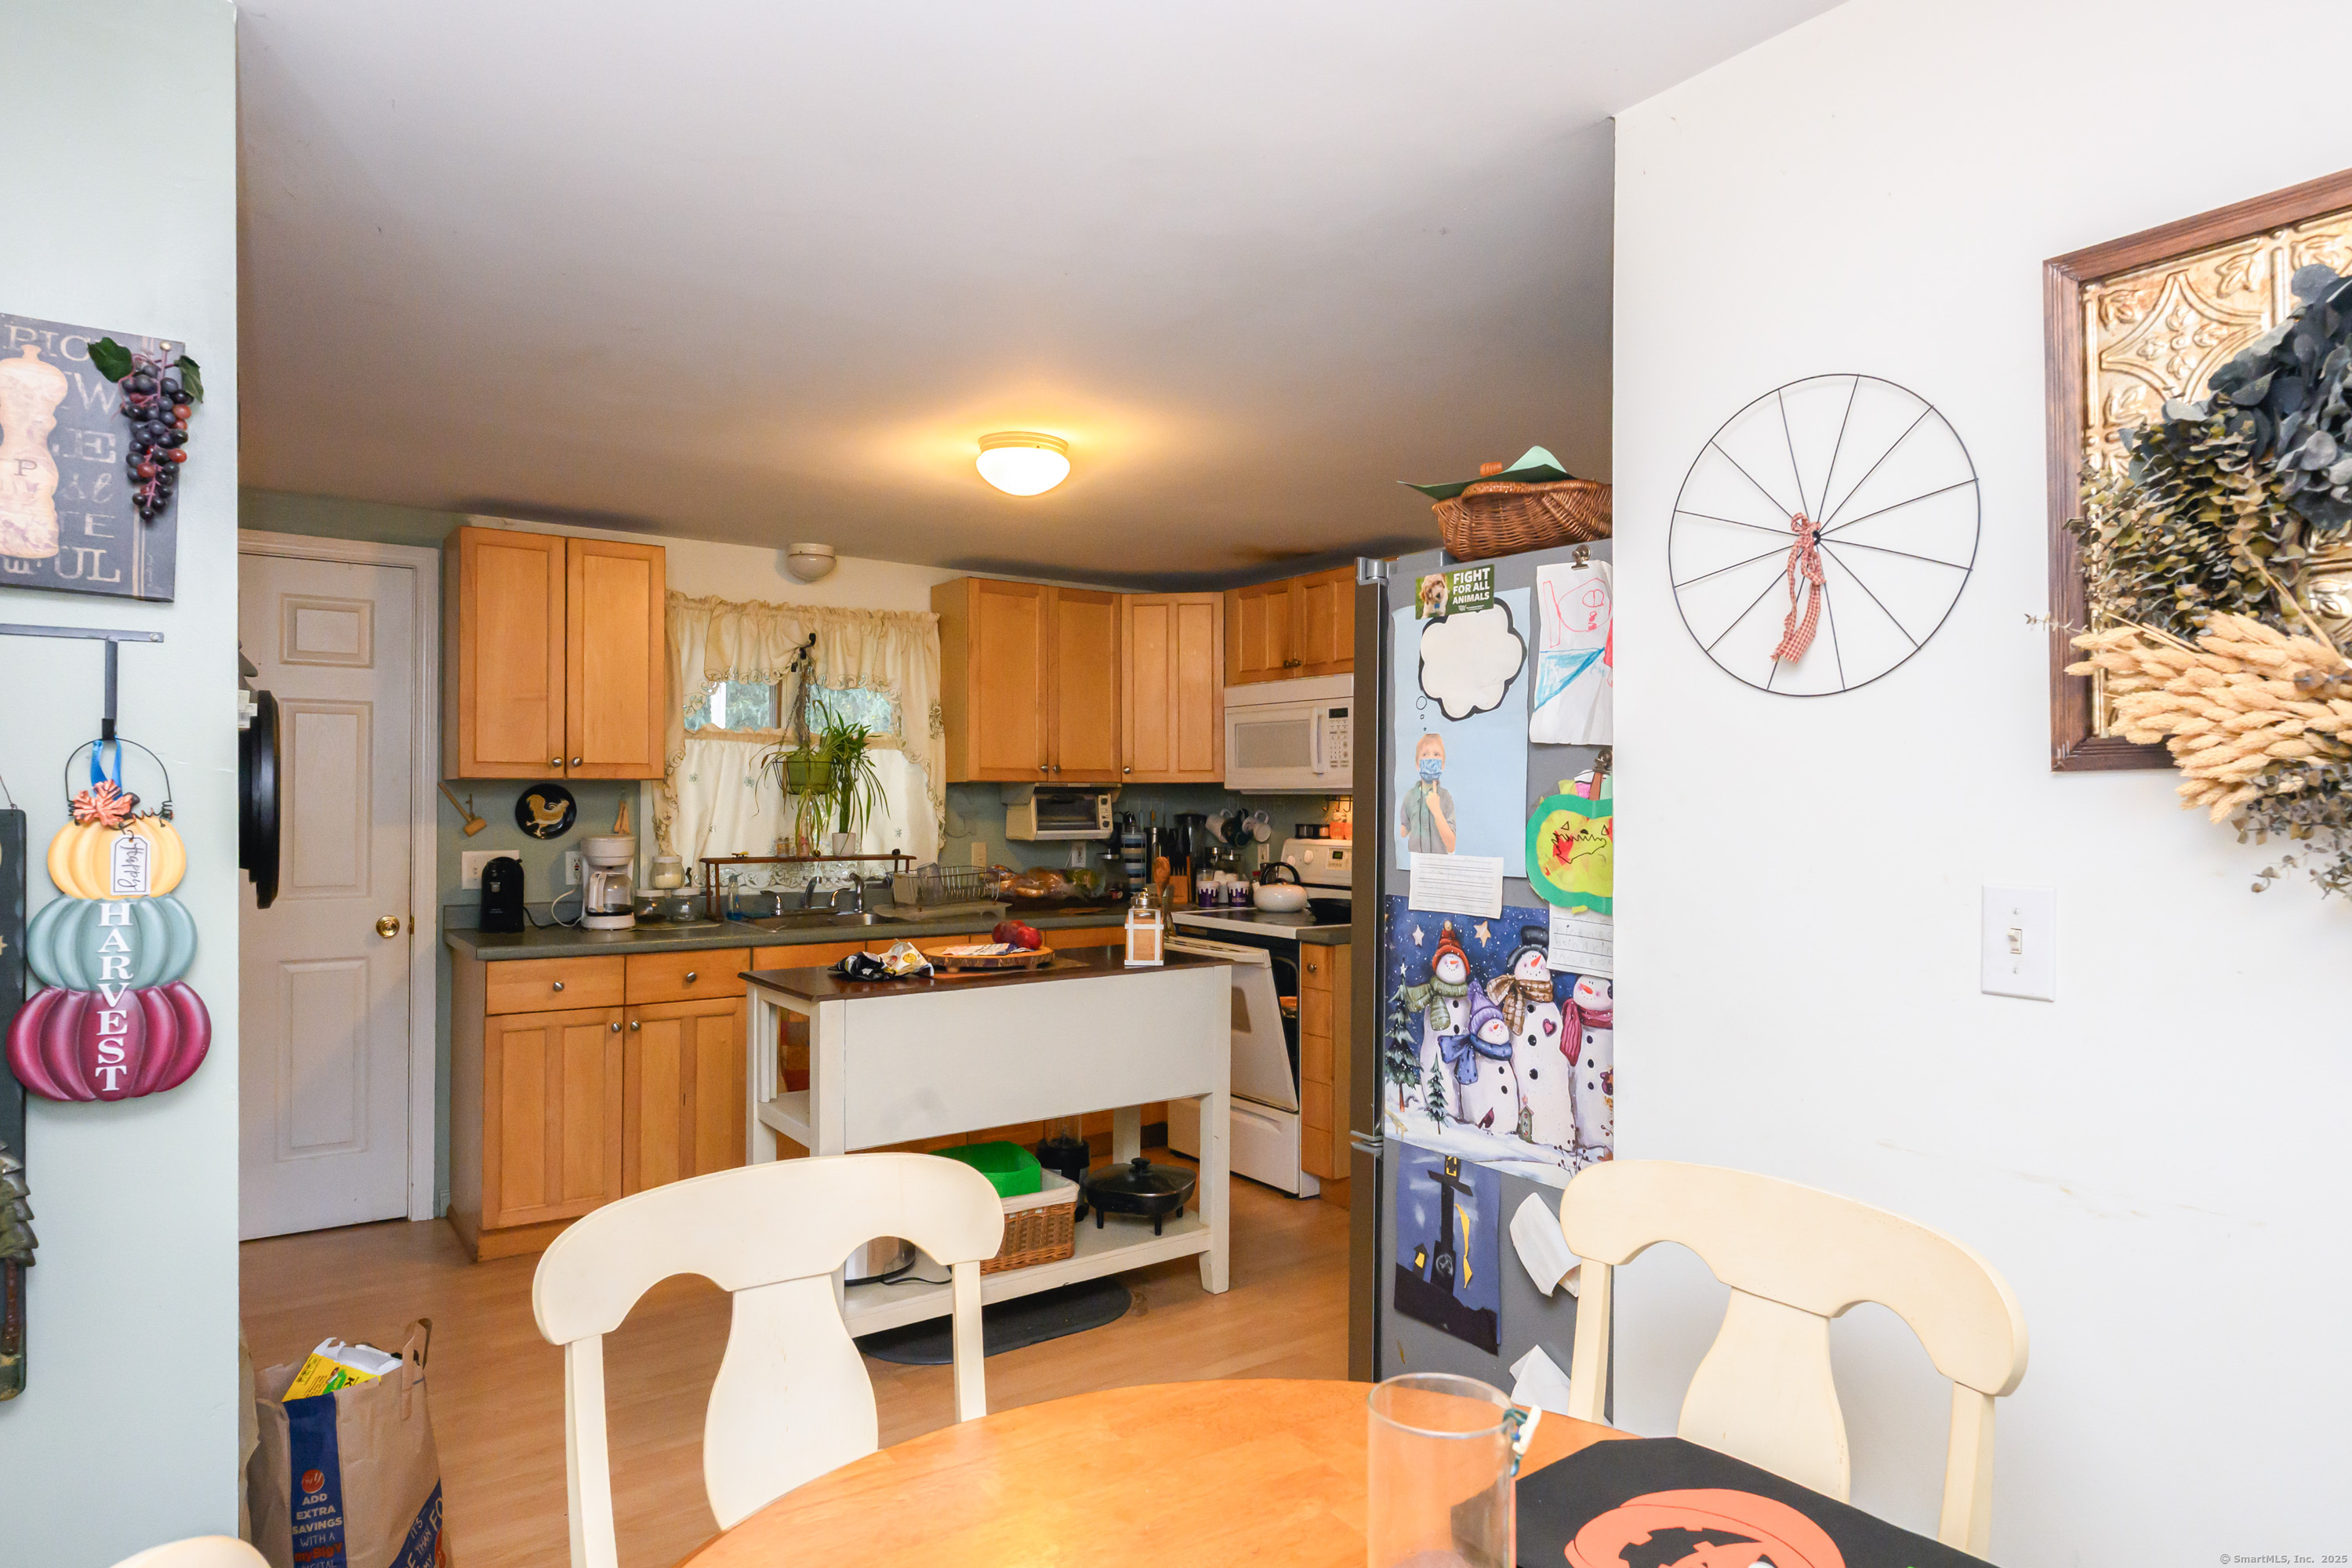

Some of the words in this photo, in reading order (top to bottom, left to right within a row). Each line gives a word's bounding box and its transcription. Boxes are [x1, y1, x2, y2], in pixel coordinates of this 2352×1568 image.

[4, 324, 93, 362] PIC
[1454, 568, 1490, 585] FIGHT
[1453, 584, 1471, 595] FOR
[1472, 581, 1490, 592] ALL
[1452, 592, 1490, 604] ANIMALS
[118, 842, 145, 891] Happy
[95, 902, 134, 1091] HARVEST
[302, 1494, 328, 1505] ADD
[296, 1505, 336, 1520] EXTRA
[292, 1517, 343, 1535] SAVINGS
[300, 1534, 326, 1547] WITH
[329, 1532, 336, 1541] A
